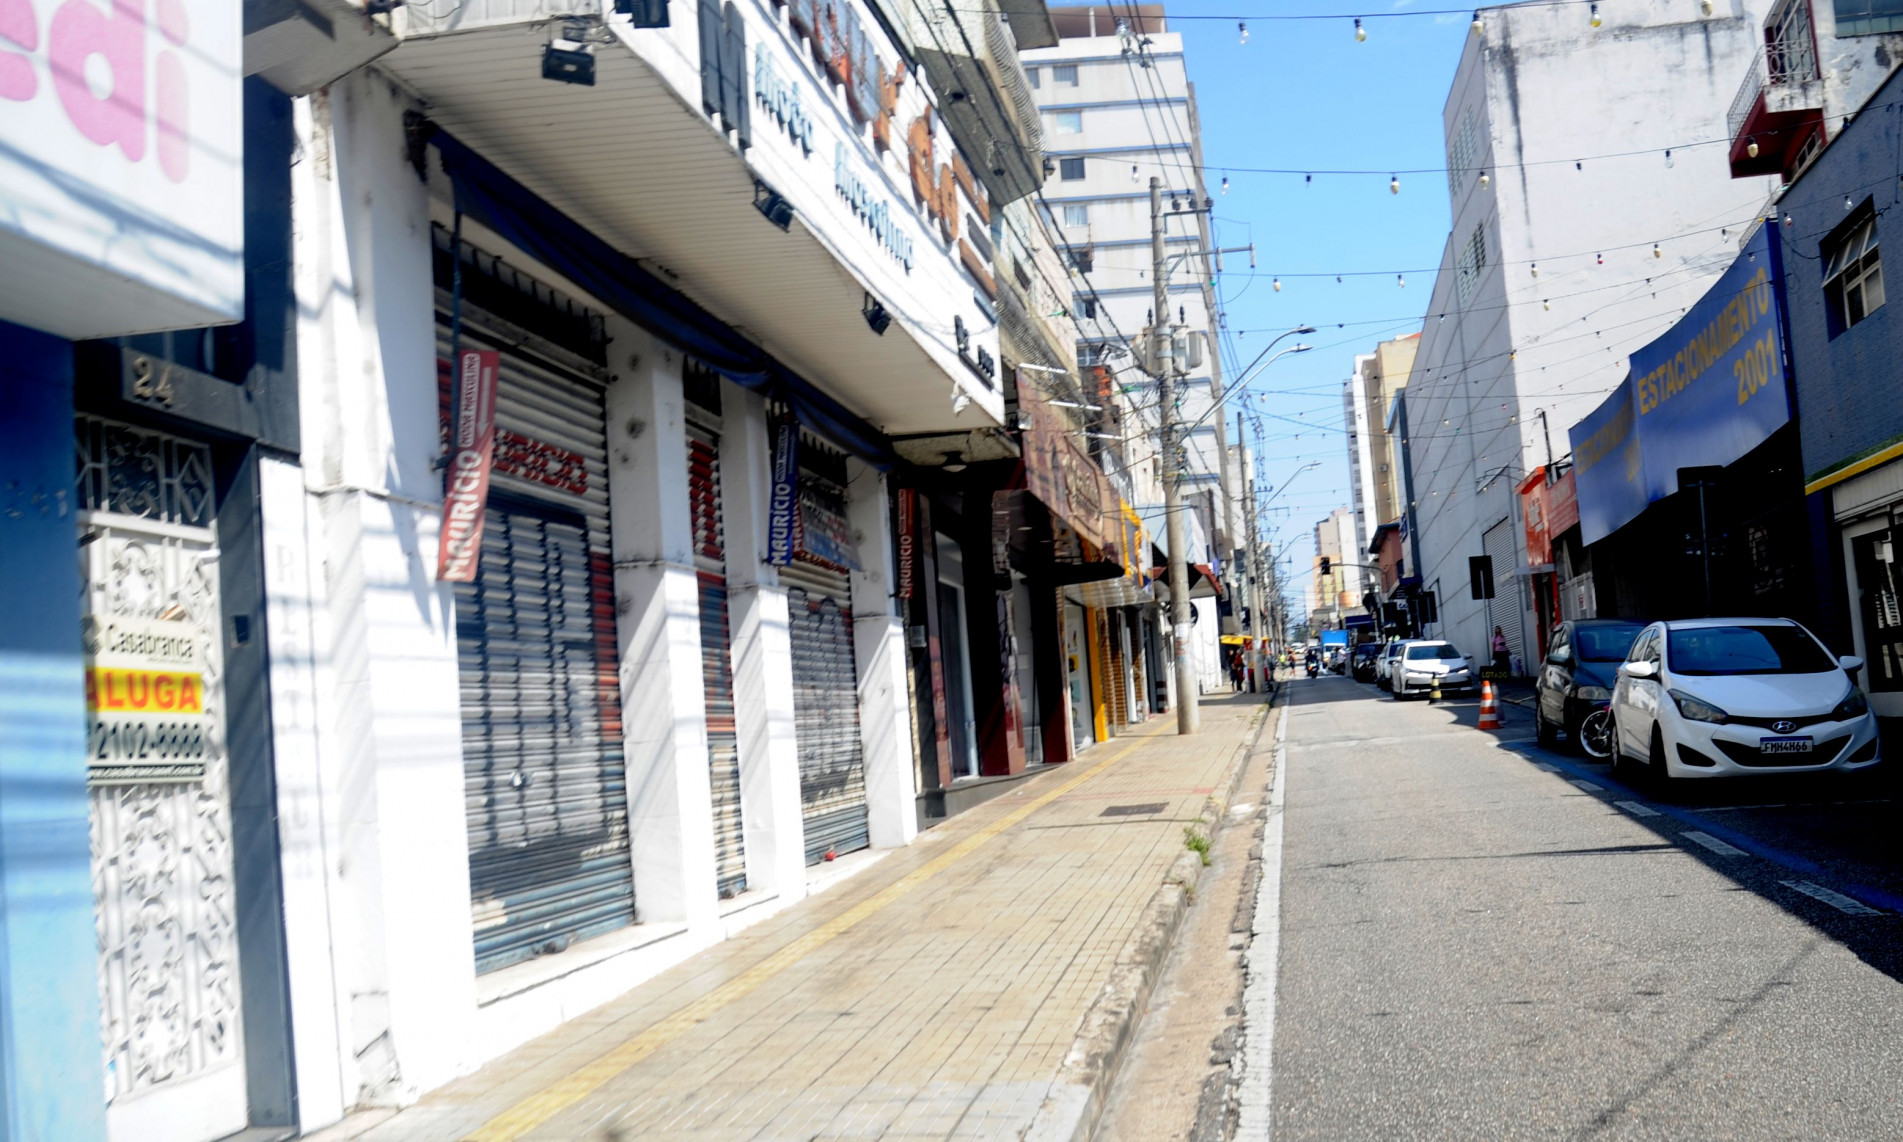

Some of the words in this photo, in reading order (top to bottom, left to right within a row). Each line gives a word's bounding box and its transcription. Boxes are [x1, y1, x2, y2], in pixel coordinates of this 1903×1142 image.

[1637, 266, 1769, 415] ESTACIONAMENTO
[1733, 328, 1778, 406] 2001
[132, 357, 175, 408] 24
[444, 450, 483, 580] MAURÍCIO
[771, 483, 791, 566] MAURÍCIO
[105, 624, 193, 658] Casabranca
[85, 668, 198, 711] ALUGA
